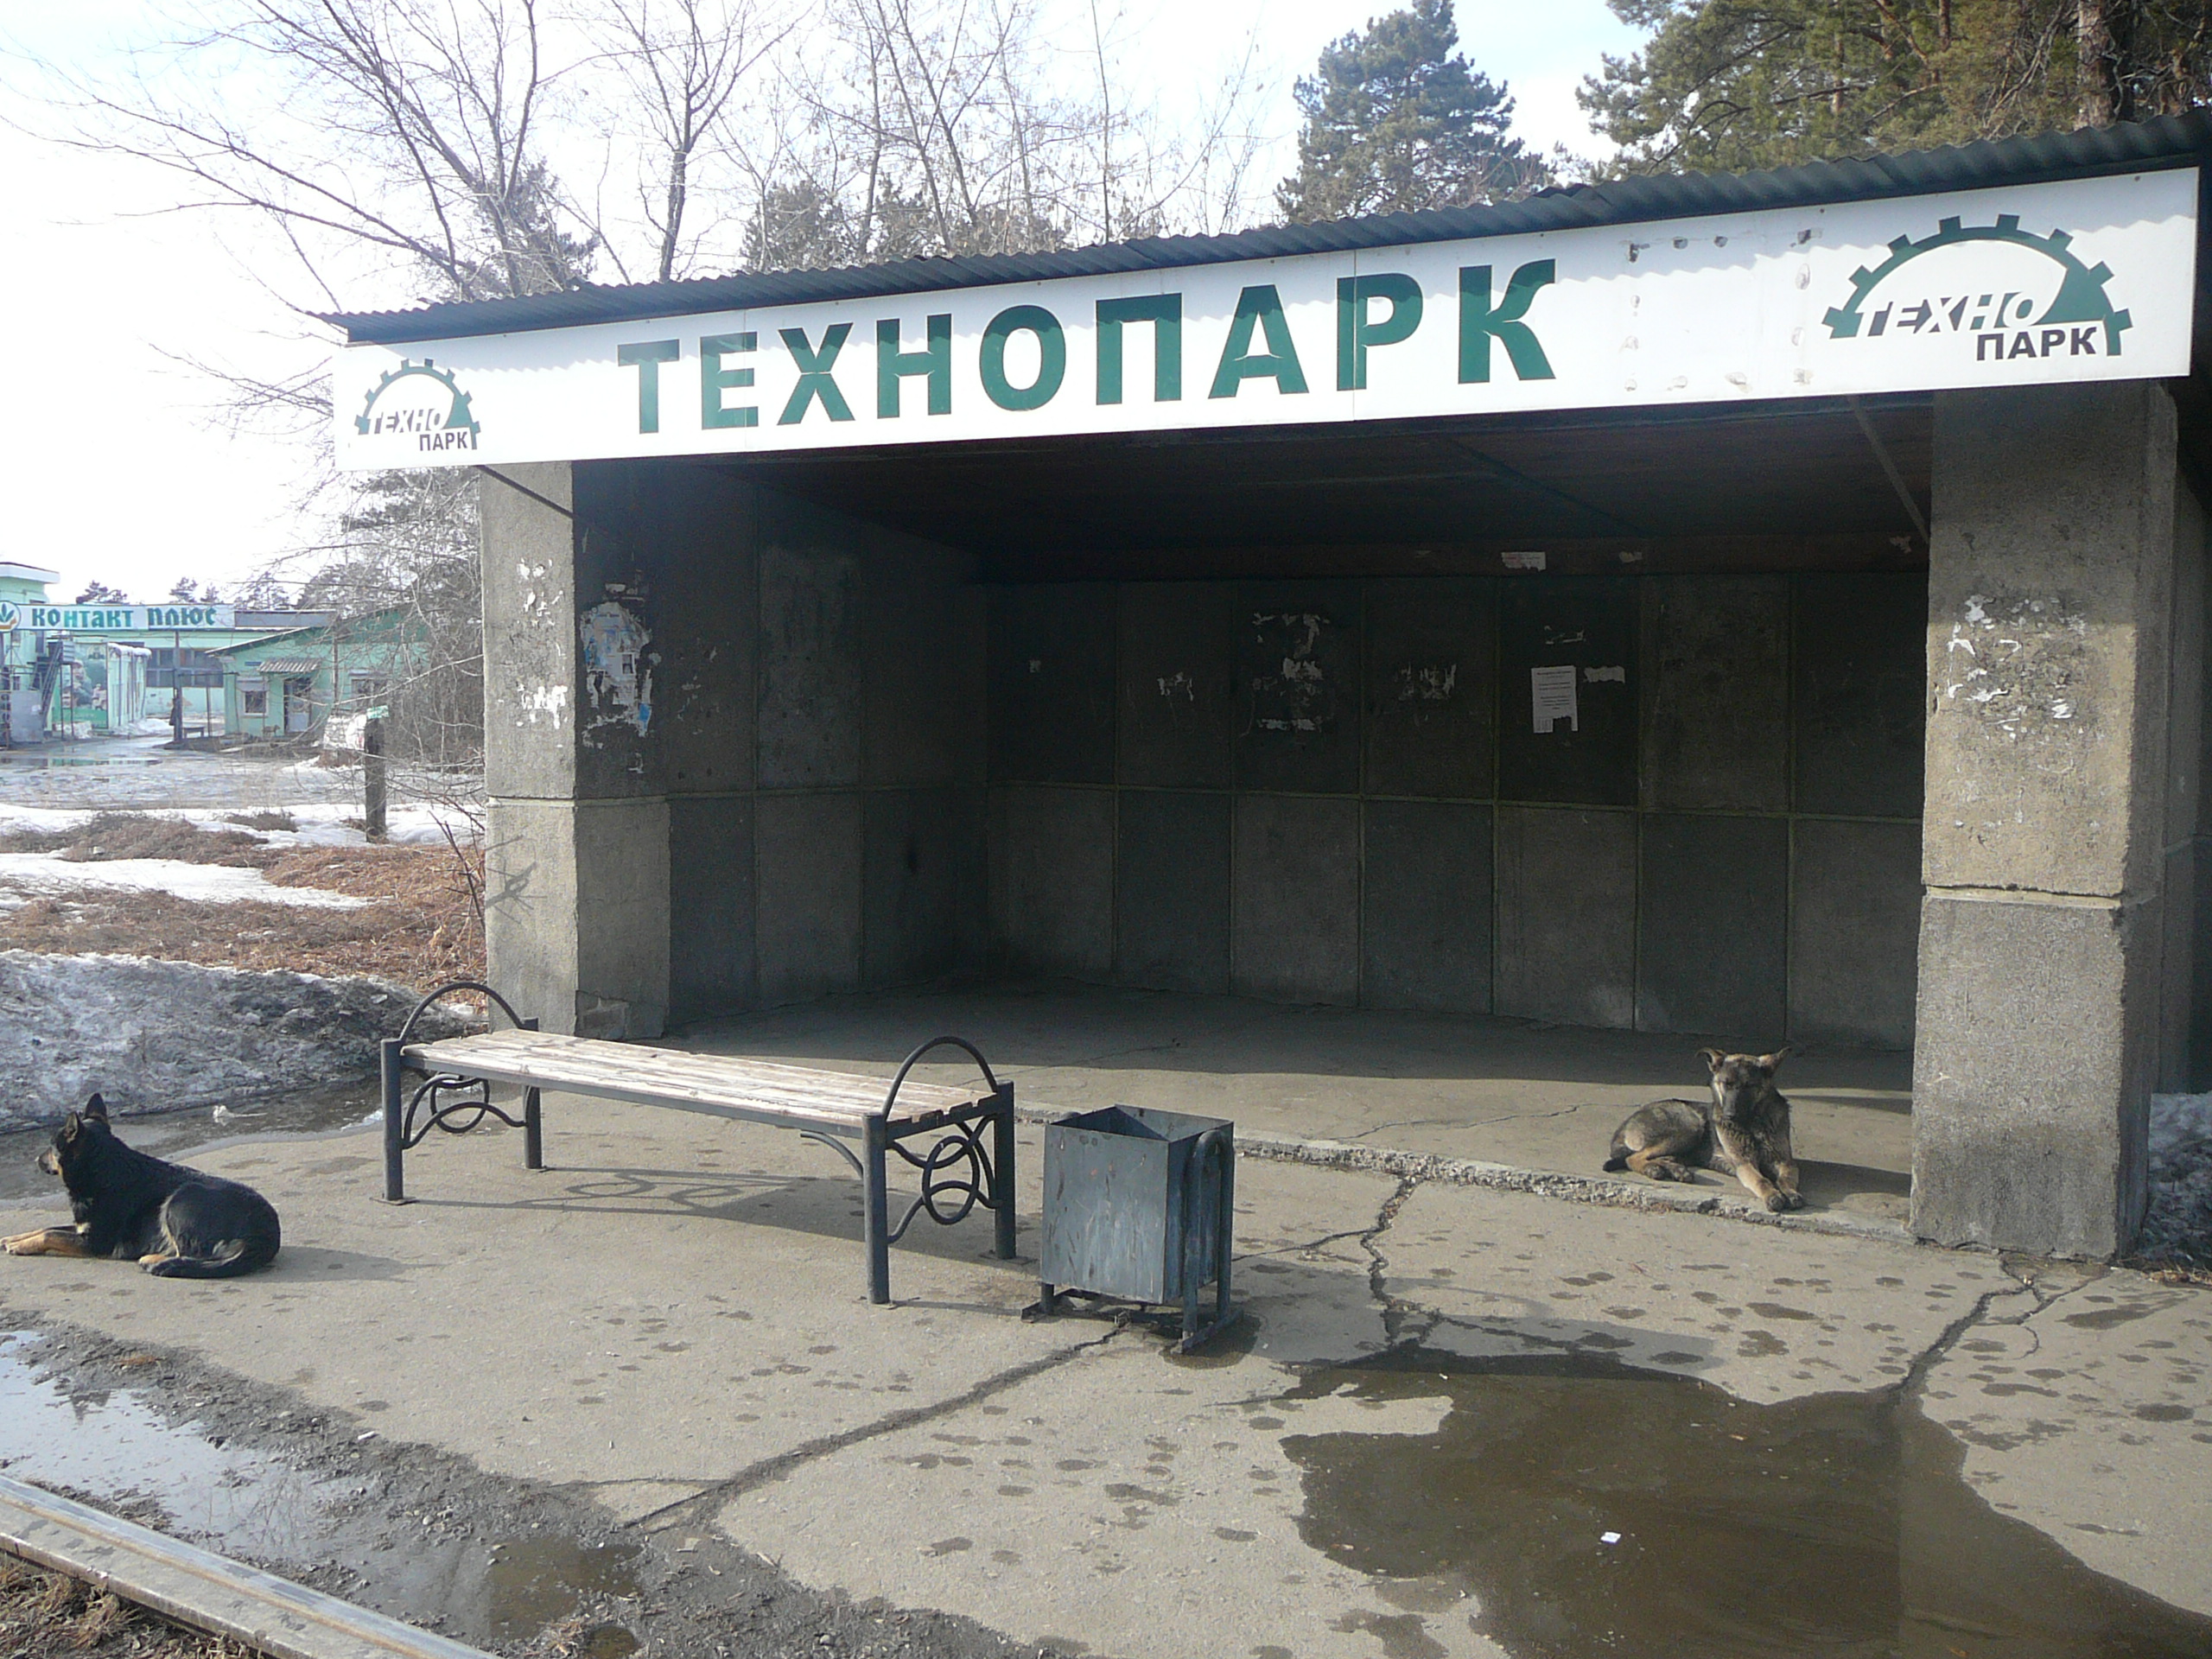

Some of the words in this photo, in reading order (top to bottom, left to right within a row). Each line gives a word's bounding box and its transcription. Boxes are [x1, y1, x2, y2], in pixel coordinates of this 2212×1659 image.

[1854, 291, 2039, 338] ТЕХНО
[617, 258, 1557, 435] ТЕХНОПАРК
[1976, 326, 2097, 361] ПАРК
[366, 408, 445, 434] ТЕХНО
[419, 431, 468, 452] ПАРК
